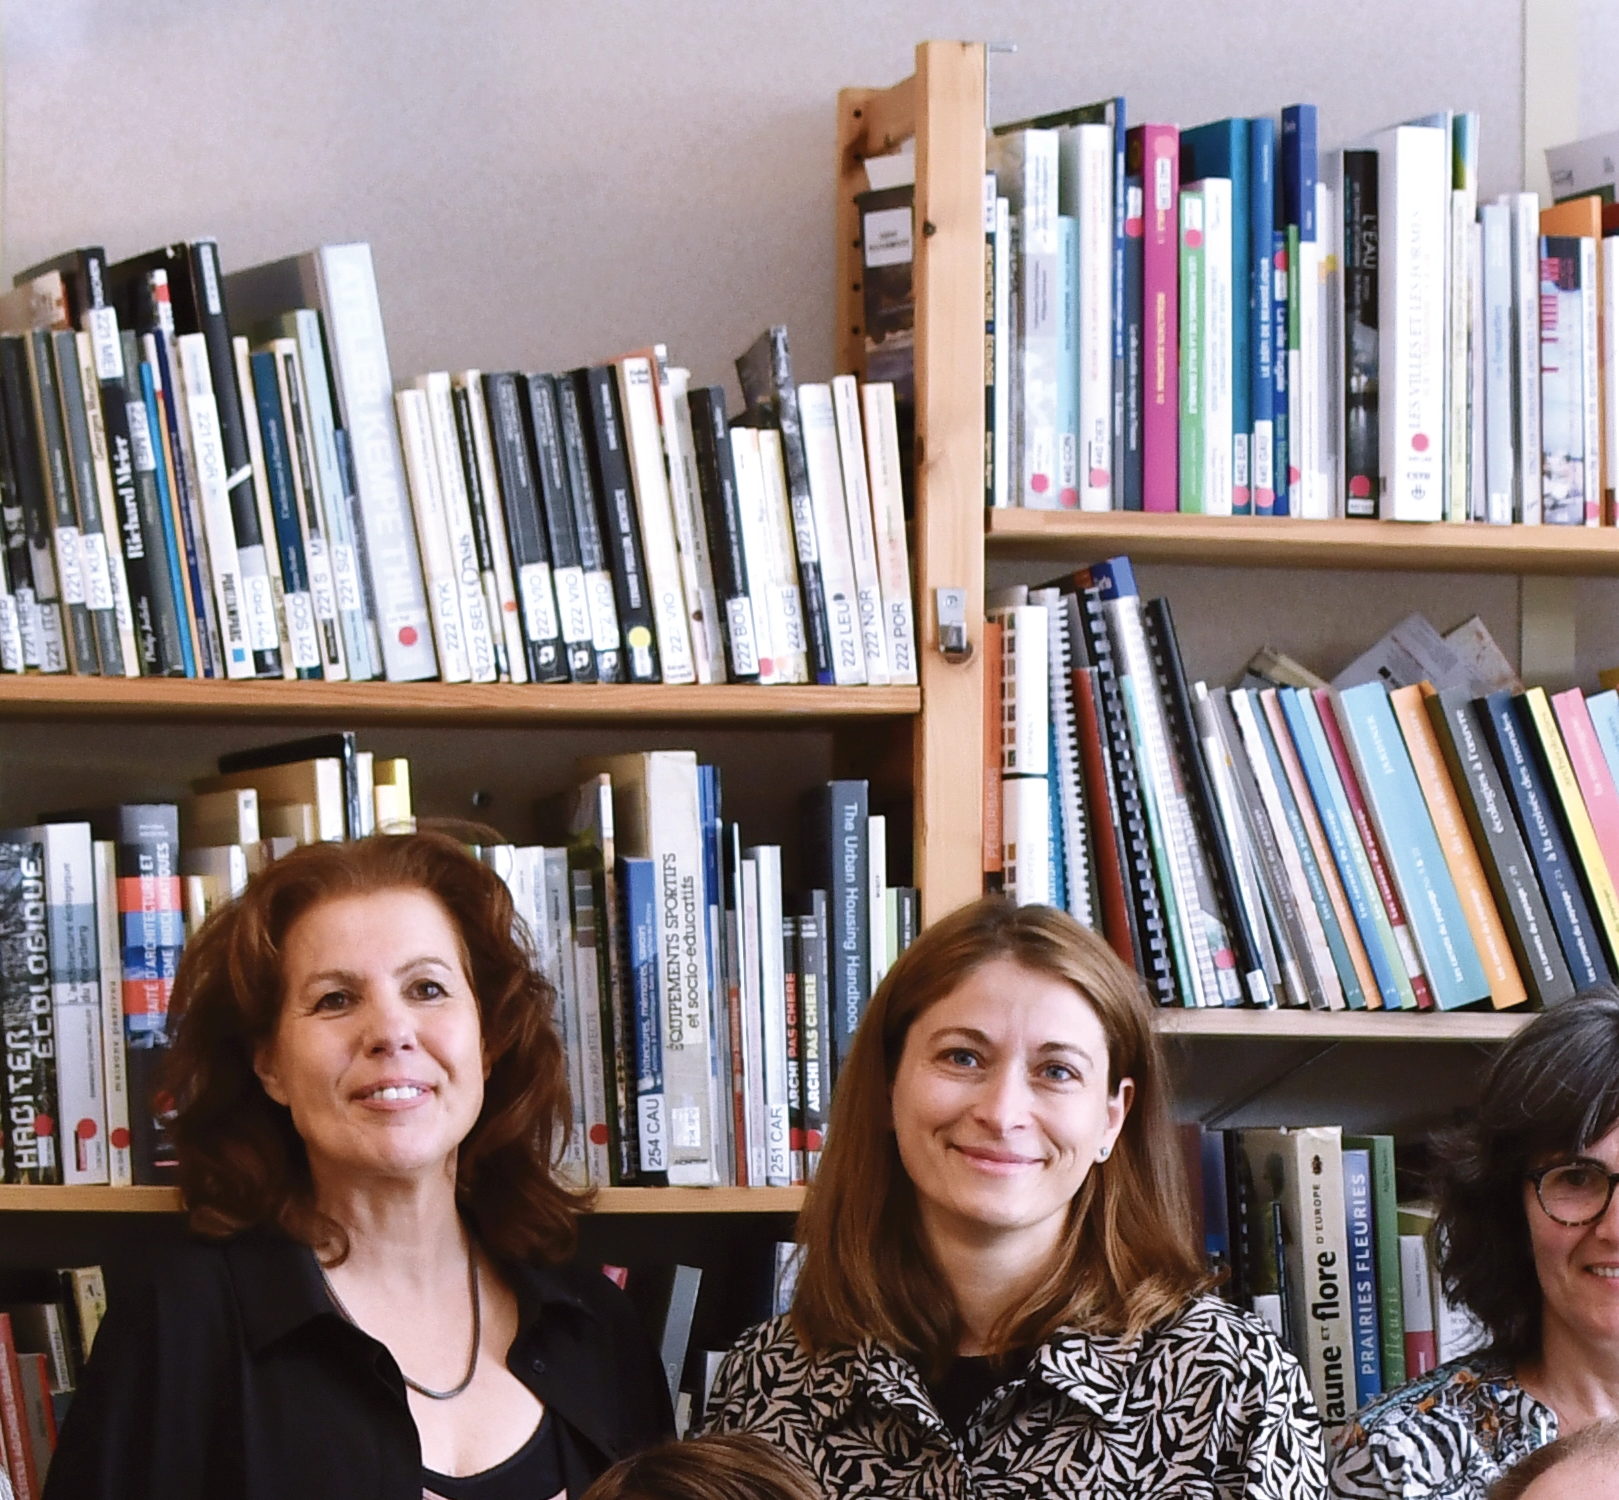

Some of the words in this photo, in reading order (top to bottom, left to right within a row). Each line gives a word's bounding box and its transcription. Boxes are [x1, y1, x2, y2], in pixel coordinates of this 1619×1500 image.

[1408, 282, 1423, 311] LES
[1407, 340, 1423, 397] VILLES
[1407, 400, 1422, 428] LES
[114, 436, 134, 485] Meier
[121, 487, 145, 558] Richard
[536, 603, 550, 636] 222
[570, 604, 585, 635] 222
[835, 601, 852, 635] LEU
[860, 589, 876, 628] NOR
[892, 603, 907, 639] POR
[737, 642, 753, 670] 222
[786, 622, 800, 649] 222
[840, 638, 855, 667] 222
[866, 631, 880, 659] 222
[896, 643, 909, 671] 222
[1500, 712, 1524, 763] mondes
[1516, 766, 1533, 789] des
[843, 802, 858, 831] The
[1474, 773, 1506, 833] écologies
[1524, 791, 1550, 837] croisée
[844, 835, 859, 883] Urban
[155, 842, 174, 946] BIOCLIMATIQUES
[662, 852, 679, 929] SPORTIFS
[1515, 887, 1534, 921] paysage
[1559, 889, 1577, 922] paysage
[141, 874, 159, 979] D'ARCHITECTURE
[679, 875, 699, 1009] socio-éducatifs
[842, 887, 860, 951] Housing
[20, 855, 54, 1059] ECOLOGIQUE
[1530, 933, 1551, 965] carnets
[1574, 936, 1593, 965] carnets
[664, 933, 684, 1050] ÉQUIPEMENTS
[845, 954, 861, 1033] Handbook
[1543, 965, 1555, 981] Les
[1586, 966, 1597, 981] Les
[145, 980, 160, 1026] TRAITÉ
[785, 972, 797, 1026] CHERE
[804, 973, 817, 1027] CHERE
[786, 1029, 798, 1057] PAS
[806, 1028, 818, 1059] PAS
[5, 1029, 38, 1168] HABITER
[788, 1060, 800, 1110] ARCHI
[808, 1061, 821, 1113] ARCHI
[644, 1098, 661, 1134] CAU
[647, 1136, 662, 1167] 254
[771, 1145, 783, 1173] 251
[1312, 1183, 1324, 1245] D'EUROPE
[1351, 1172, 1370, 1272] FLEURIES
[1311, 1251, 1339, 1321] flore
[1357, 1280, 1376, 1375] PRAIRIES
[1320, 1346, 1347, 1428] faune
